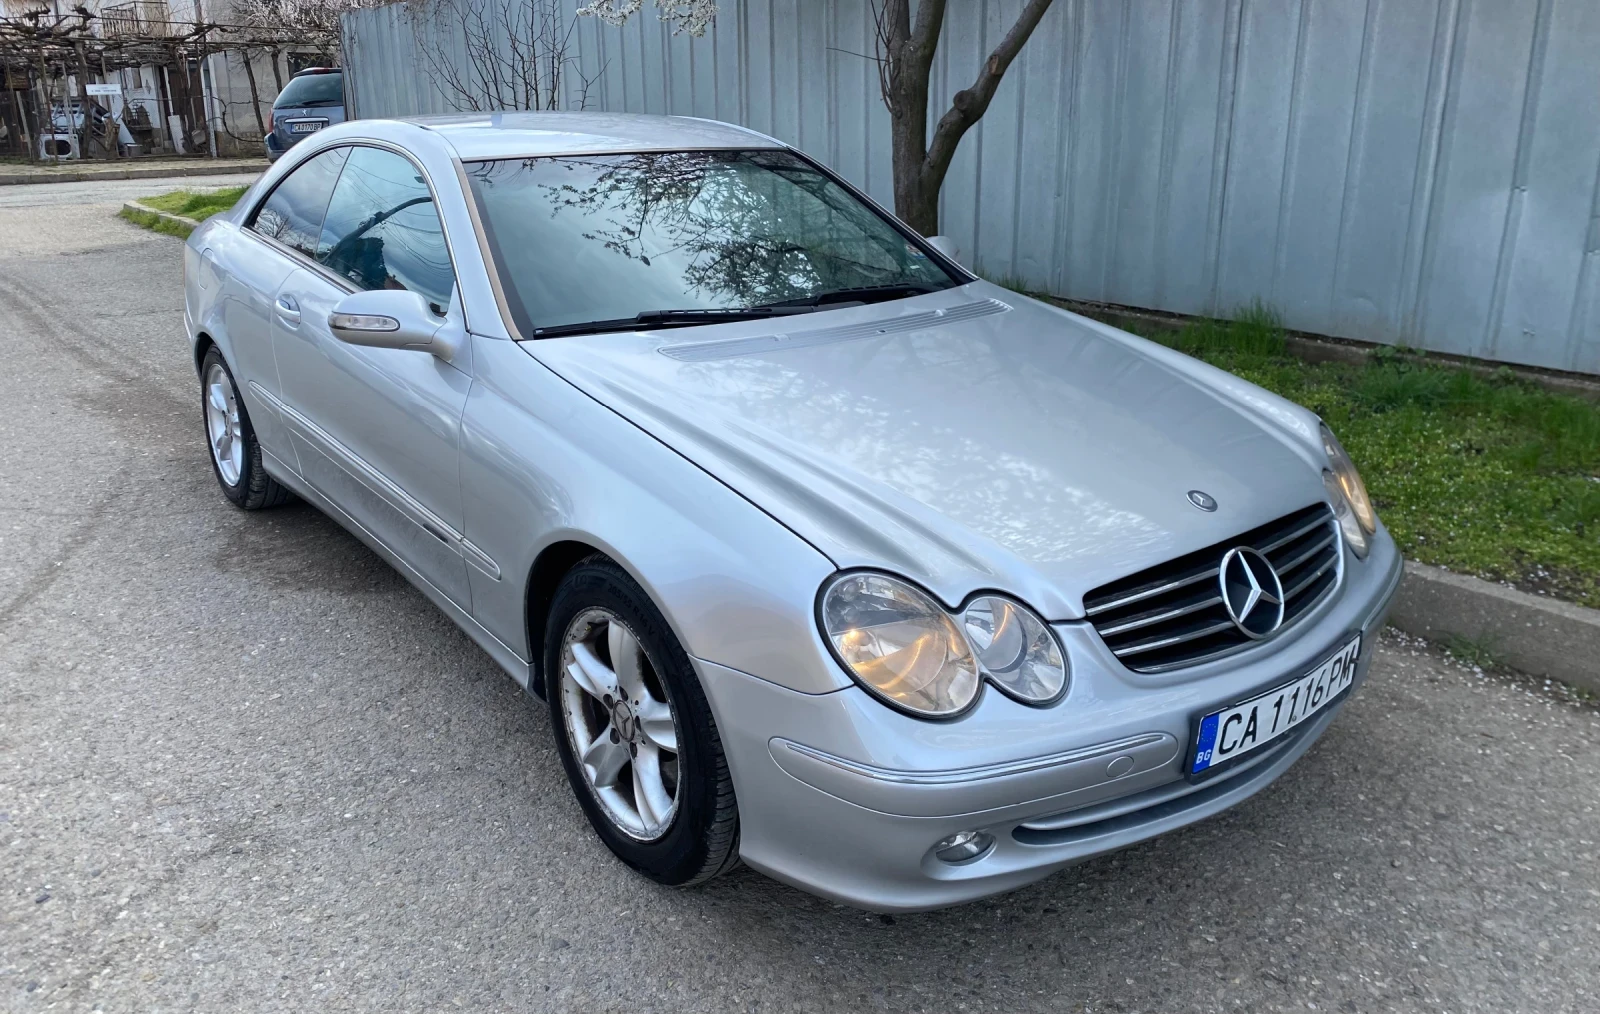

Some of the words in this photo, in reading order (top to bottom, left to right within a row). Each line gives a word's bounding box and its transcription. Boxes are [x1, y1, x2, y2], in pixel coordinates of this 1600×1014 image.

[1218, 706, 1258, 755] CA
[1271, 669, 1327, 733] 1116
[1196, 749, 1212, 764] BG
